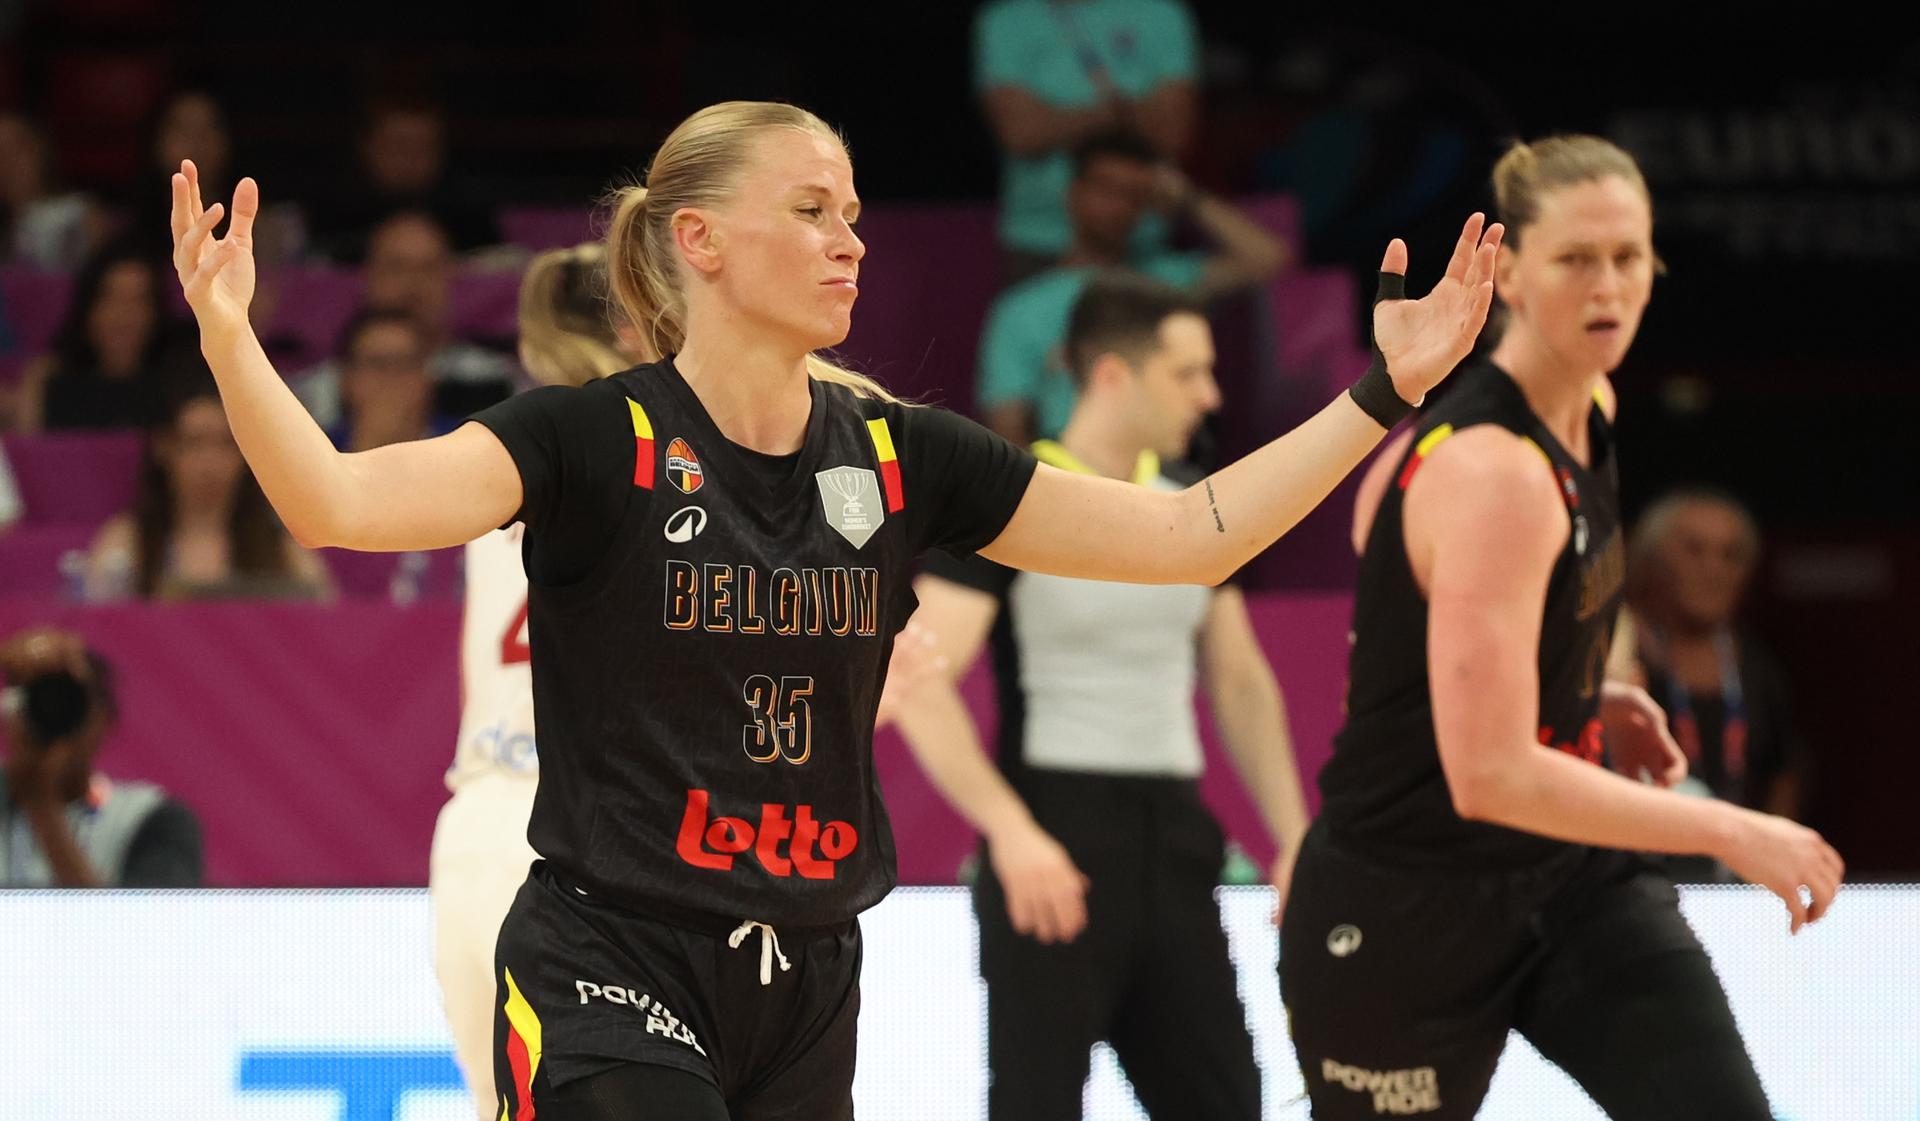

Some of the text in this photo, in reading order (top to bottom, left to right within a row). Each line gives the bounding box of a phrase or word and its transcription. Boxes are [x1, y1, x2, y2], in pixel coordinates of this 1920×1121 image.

[664, 560, 879, 637] BELGIUM
[743, 674, 814, 765] 35
[675, 789, 858, 880] Lotto
